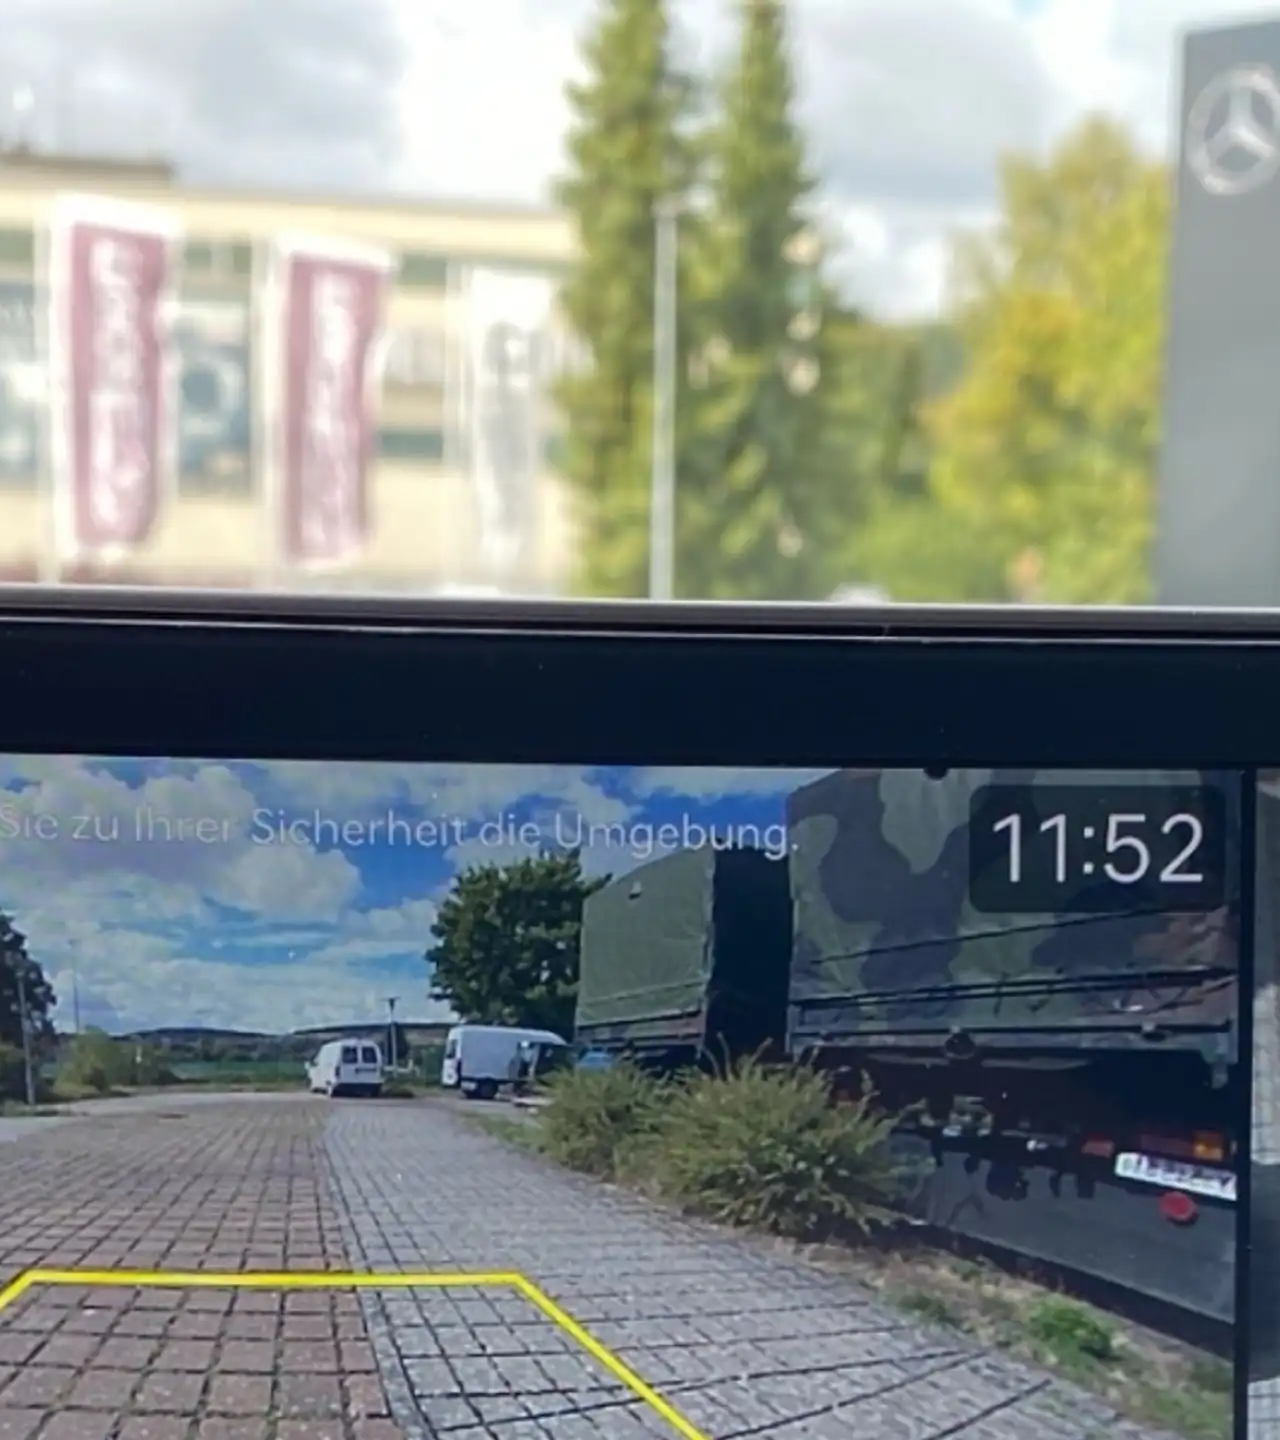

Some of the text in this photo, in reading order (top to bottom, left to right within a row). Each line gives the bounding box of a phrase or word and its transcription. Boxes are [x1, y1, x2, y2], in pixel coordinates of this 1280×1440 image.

[72, 815, 119, 840] zu
[134, 806, 230, 843] Ihrer
[251, 808, 466, 847] Sicherheit
[479, 813, 542, 848] die
[553, 813, 798, 860] Umgebung.
[993, 813, 1204, 883] 11:52
